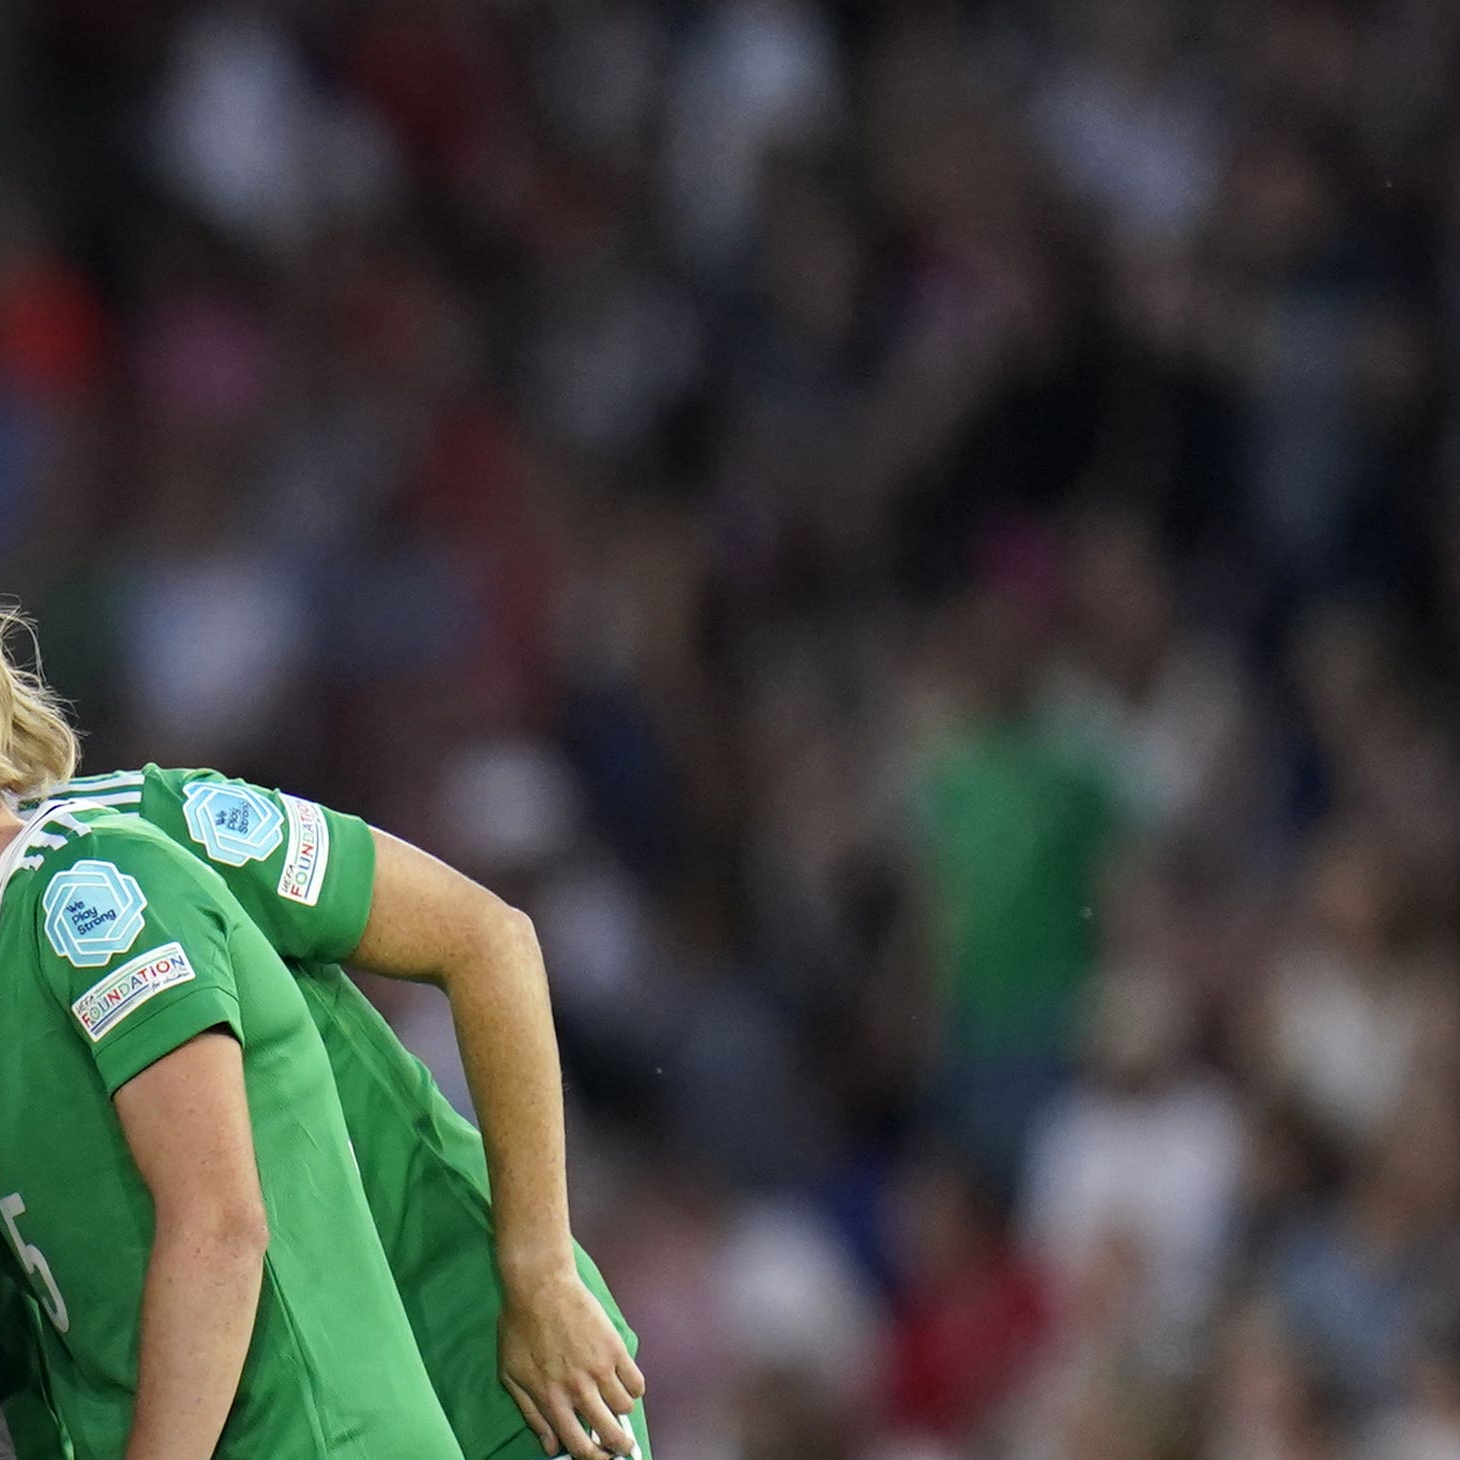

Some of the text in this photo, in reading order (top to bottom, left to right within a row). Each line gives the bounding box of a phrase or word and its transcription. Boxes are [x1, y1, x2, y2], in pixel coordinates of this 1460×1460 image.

[281, 864, 294, 893] UEFA
[65, 900, 85, 914] We
[72, 906, 98, 926] Play
[77, 908, 116, 935] Strong
[81, 954, 186, 1028] FOUNDATION
